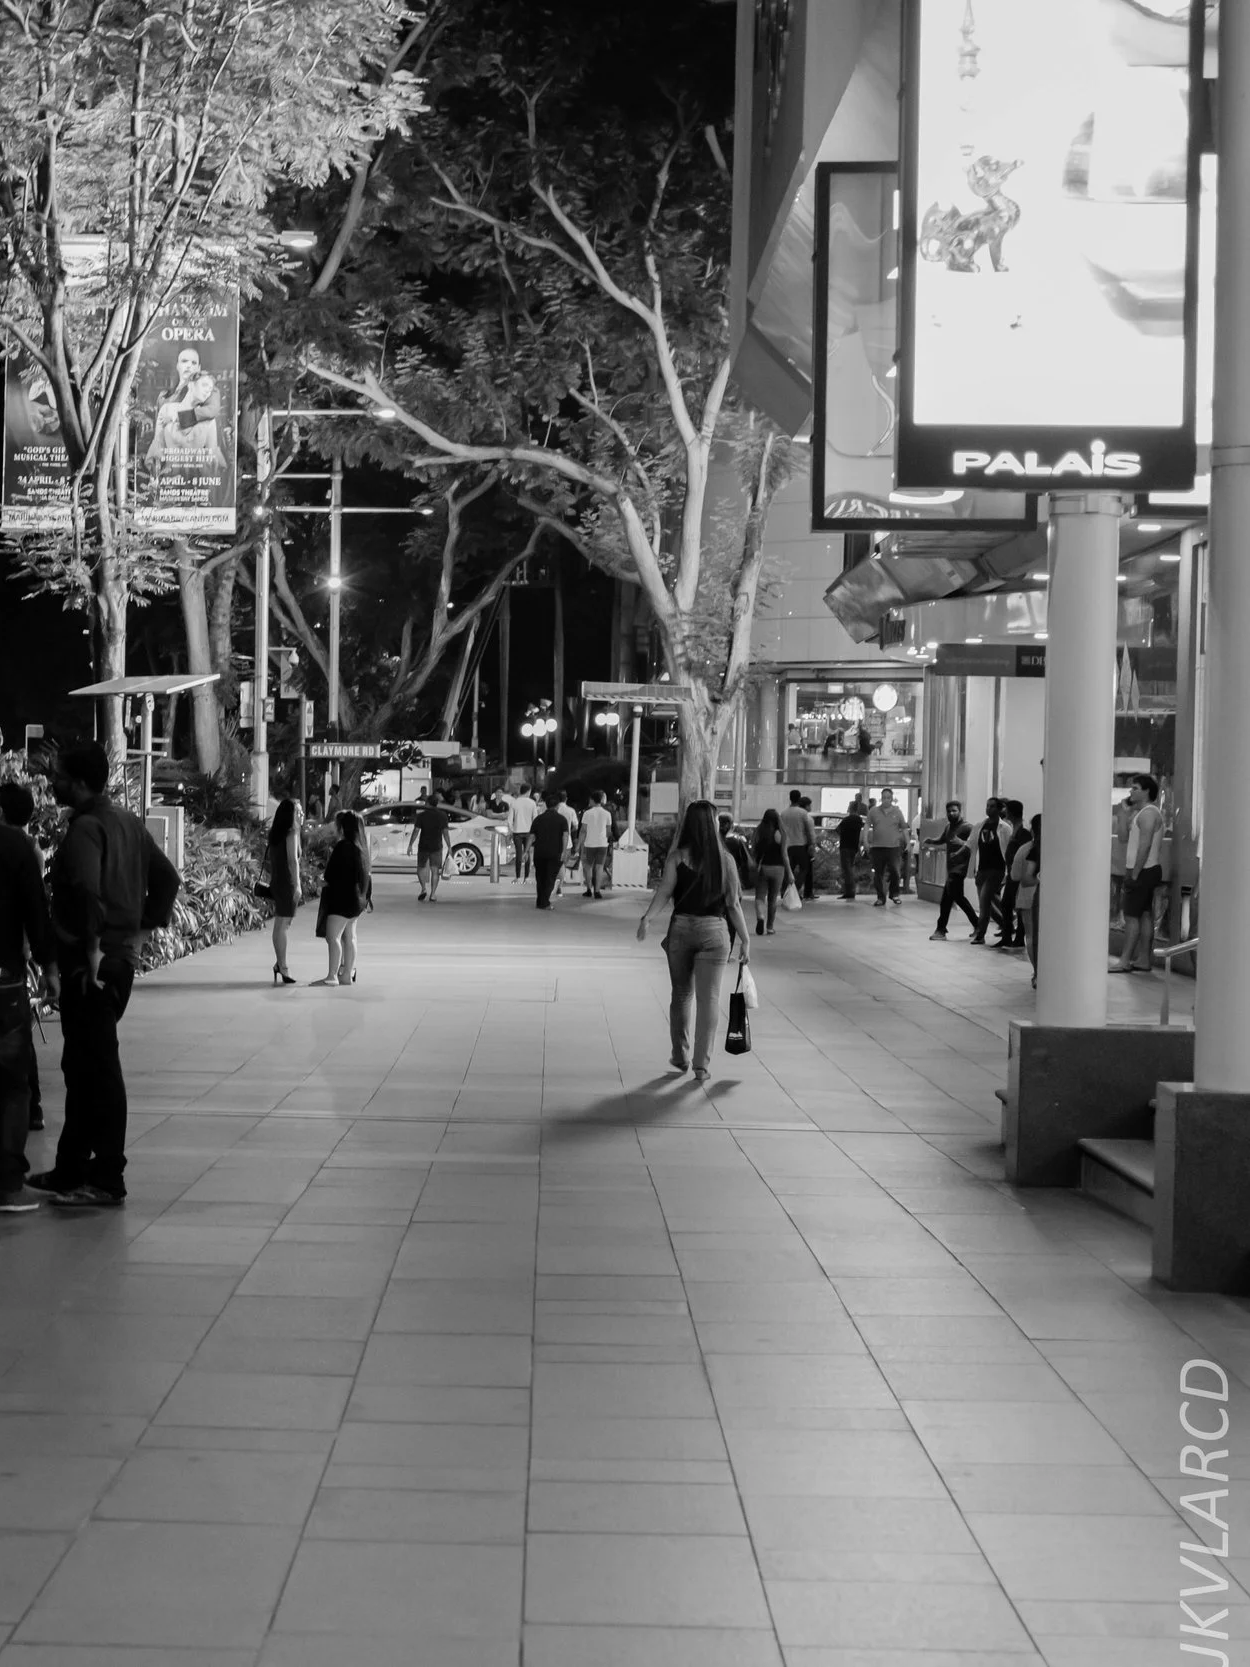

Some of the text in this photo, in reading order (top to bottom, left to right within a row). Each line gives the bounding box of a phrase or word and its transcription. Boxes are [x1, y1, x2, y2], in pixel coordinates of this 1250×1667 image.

[161, 327, 216, 342] OPERA
[13, 453, 48, 461] MUSICAL
[28, 475, 54, 485] APRIL
[160, 477, 186, 486] APRIL
[199, 477, 221, 487] JUNE
[311, 745, 375, 757] CLAYMORE RD
